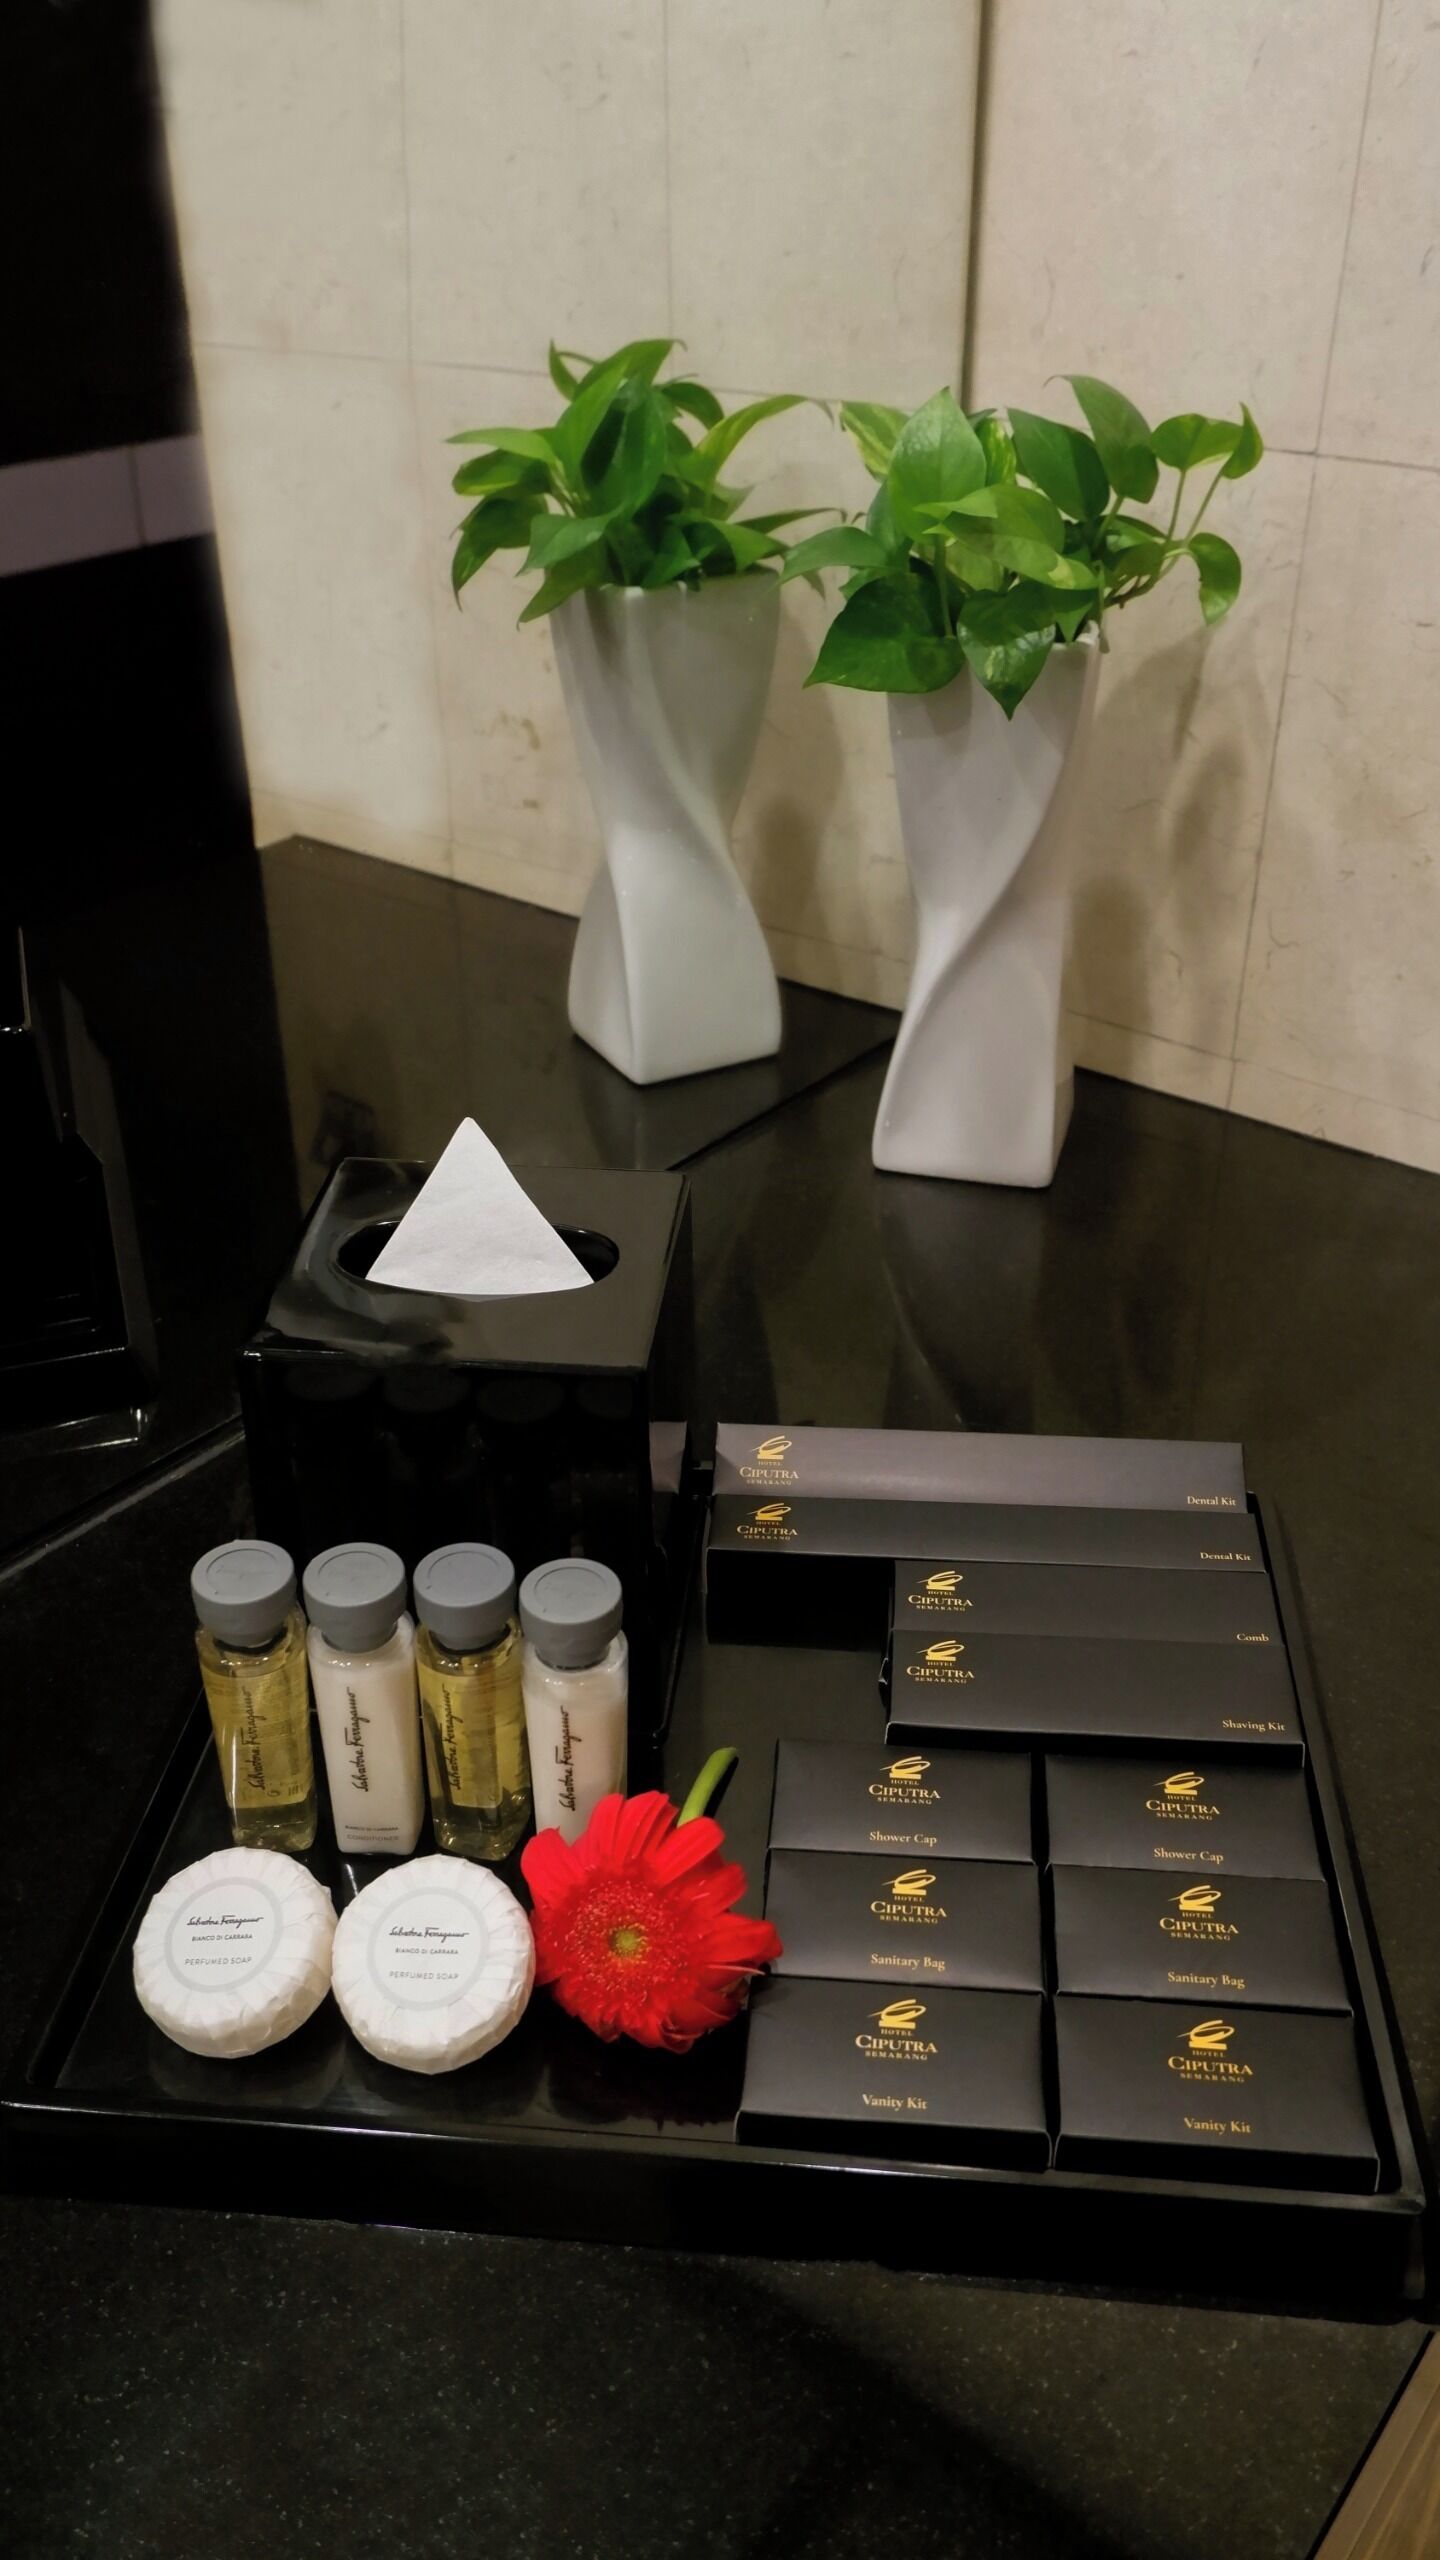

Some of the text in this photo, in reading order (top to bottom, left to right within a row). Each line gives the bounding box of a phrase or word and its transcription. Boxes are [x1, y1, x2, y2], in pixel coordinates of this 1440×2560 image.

[740, 1467, 800, 1478] CIPUTRA
[1187, 1496, 1236, 1506] Dental Kit
[737, 1525, 798, 1535] CIPUTRA
[1200, 1552, 1251, 1561] Dental Kit
[908, 1595, 974, 1607] CIPUTRA
[1236, 1633, 1269, 1642] Comb
[906, 1666, 975, 1679] CIPUTRA
[1222, 1720, 1286, 1733] Shaving Kit
[869, 1784, 941, 1799] CIPUTRA
[878, 1797, 933, 1805] SEMARANG
[1146, 1800, 1220, 1815] CIPUTRA
[1156, 1812, 1213, 1821] SEMARANG
[870, 1831, 937, 1847] Shower Cap
[1154, 1848, 1224, 1864] Shower Cap
[870, 1901, 947, 1918] CIPUTRA
[880, 1916, 938, 1924] SEMARANG
[1159, 1917, 1239, 1934] CIPUTRA
[1171, 1932, 1231, 1941] SEMARANG
[185, 1958, 228, 1966] PERFUMED
[871, 1953, 945, 1971] Sanitary Bag
[389, 1971, 434, 1979] PERFUMED
[1168, 1971, 1245, 1989] Sanitary Bag
[855, 2034, 938, 2053] CIPUTRA
[865, 2051, 928, 2061] SEMARANG
[1192, 2050, 1225, 2058] HOTEL
[1168, 2056, 1253, 2075] CIPUTRA
[1180, 2073, 1245, 2083] SEMARANG
[862, 2094, 928, 2111] Vanity Kit
[1184, 2117, 1252, 2135] Vanity Kit
